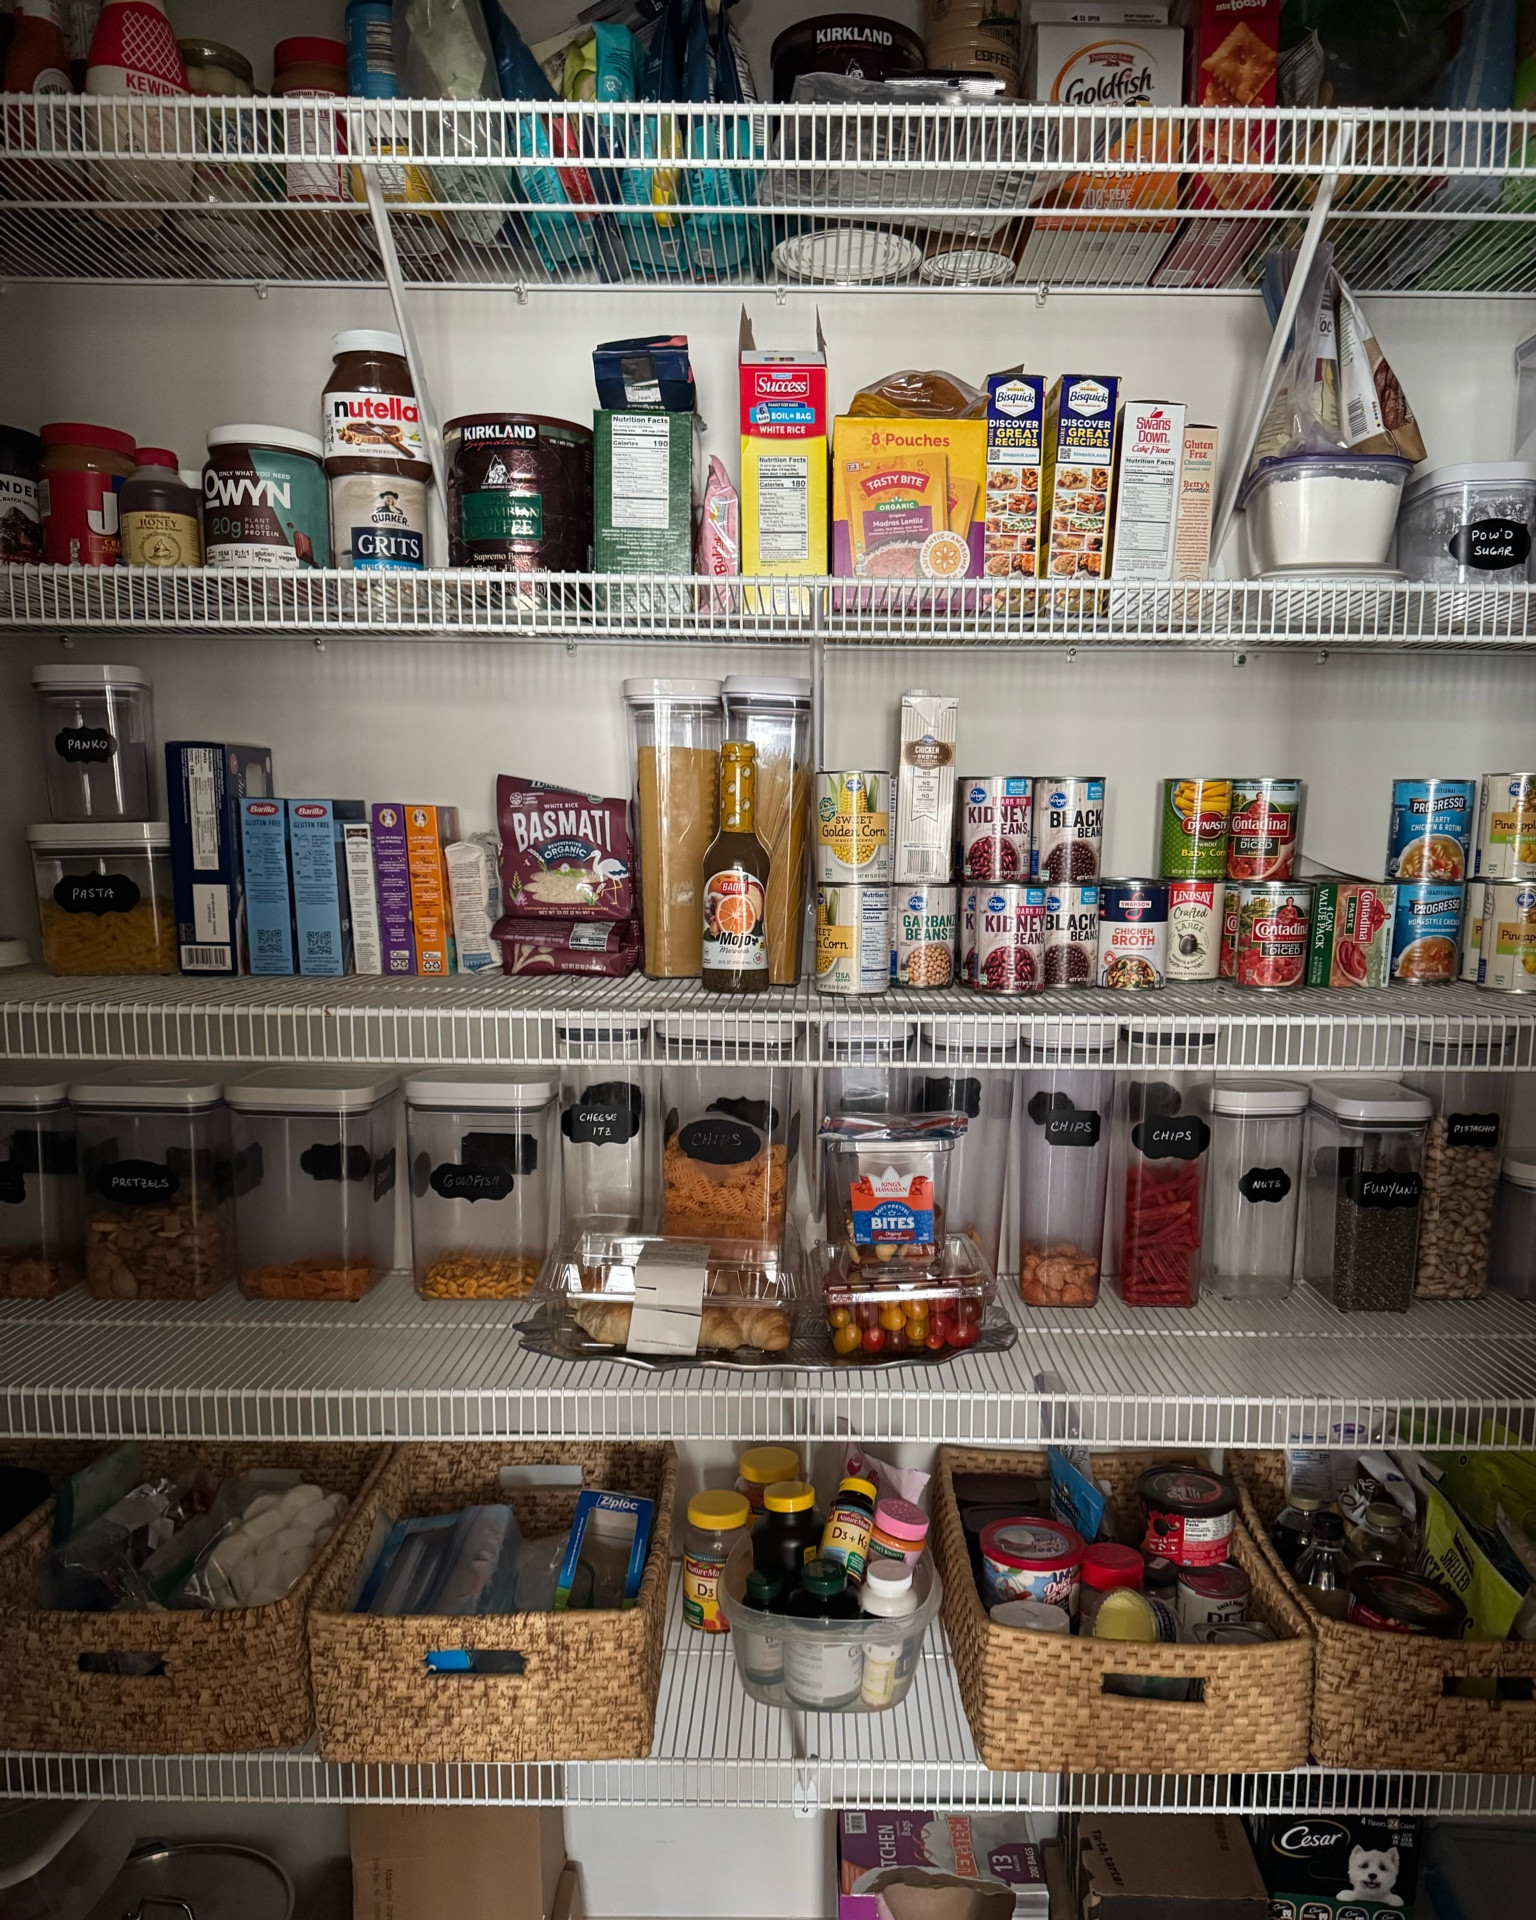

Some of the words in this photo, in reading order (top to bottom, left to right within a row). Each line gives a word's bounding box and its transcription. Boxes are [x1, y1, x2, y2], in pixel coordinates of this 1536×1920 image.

[815, 26, 894, 46] KIRKLAND
[975, 49, 1012, 66] COFFEE
[1064, 67, 1153, 104] Goldfish
[757, 378, 808, 394] Success
[997, 390, 1035, 405] Bisquick
[1069, 390, 1108, 405] Bisquick
[334, 398, 419, 424] nutella
[771, 411, 790, 421] BOIL
[795, 411, 812, 421] BAG
[612, 415, 645, 424] Nutrition
[647, 417, 669, 425] Facts
[989, 419, 1039, 429] DISCOVER
[1061, 419, 1111, 429] DISCOVER
[1136, 417, 1171, 431] Swans
[464, 425, 537, 441] KIRKLAND
[759, 425, 785, 435] WHITE
[786, 425, 806, 435] RICE
[996, 428, 1039, 439] GREAT
[1068, 428, 1111, 439] GREAT
[872, 433, 880, 446] 8
[885, 433, 951, 447] Pouches
[995, 438, 1038, 447] RECIPES
[1066, 438, 1110, 447] RECIPES
[1138, 430, 1169, 444] Down
[464, 440, 538, 452] Signature
[1132, 444, 1150, 454] Cake
[1150, 445, 1172, 455] Flour
[1184, 440, 1214, 449] Gluten
[1189, 450, 1208, 459] Free
[219, 470, 234, 478] ONLY
[272, 472, 291, 480] NEED
[204, 469, 291, 510] OWYN
[791, 480, 806, 488] 180
[866, 476, 899, 492] TASTY
[901, 474, 923, 488] BITE
[1184, 480, 1210, 490] Betty's
[879, 502, 915, 511] ORGANIC
[139, 519, 178, 529] HONEY
[371, 514, 409, 526] QUAKER
[873, 519, 900, 528] Madras
[901, 518, 923, 527] Lentils
[212, 517, 241, 538] 20g
[244, 523, 270, 531] BASED
[469, 520, 534, 537] COFFEE
[244, 530, 280, 538] PROTEIN
[1471, 528, 1514, 542] POW'D
[358, 534, 420, 559] GRITS
[921, 534, 945, 571] AUTHENTIC
[949, 534, 970, 571] AWESOME
[1472, 545, 1514, 558] SUGAR
[254, 550, 275, 559] gluten
[258, 556, 272, 564] free
[473, 552, 506, 562] Supremo
[68, 739, 108, 751] PANKO
[915, 746, 940, 754] CHICKEN
[1015, 797, 1027, 806] RED
[1413, 796, 1465, 814] PROGRESSO
[250, 805, 277, 813] Barilla
[298, 807, 325, 815] Barilla
[968, 806, 1028, 824] KIDNEY
[1050, 809, 1103, 828] BLACK
[513, 810, 612, 853] BASMATI
[822, 825, 860, 838] Golden
[862, 825, 887, 837] Corn
[991, 823, 1028, 835] BEANS
[1187, 821, 1228, 831] DYNASTY
[1231, 818, 1288, 833] Contadina
[1438, 823, 1444, 831] &
[544, 845, 588, 860] ORGANIC
[1240, 842, 1274, 850] DICED
[1181, 849, 1207, 859] Baby
[72, 887, 115, 901] PASTA
[1173, 890, 1213, 902] LINDSAY
[1016, 907, 1032, 915] DARK
[1318, 888, 1329, 921] VALUE
[1413, 898, 1460, 915] PROGRESSO
[1173, 906, 1209, 920] Crafted
[1347, 902, 1355, 929] PASTE
[1359, 890, 1374, 941] Contadina
[985, 915, 1046, 933] KIDNEY
[1046, 913, 1097, 931] BLACK
[1324, 912, 1333, 931] CAN
[905, 928, 948, 941] BEANS
[1114, 927, 1154, 937] CHICKEN
[1175, 924, 1205, 933] LARGE
[720, 931, 752, 948] Mojo
[1013, 933, 1045, 945] BEANS
[1070, 931, 1098, 942] BEANS
[1111, 936, 1156, 947] BROTH
[1314, 922, 1324, 949] PACK
[823, 939, 849, 951] Corn
[1269, 948, 1301, 956] DICED
[835, 972, 850, 980] USA
[579, 1112, 618, 1122] CHEESE
[591, 1126, 612, 1136] ITZ
[1050, 1121, 1093, 1134] CHIPS
[691, 1132, 742, 1147] CHIPS
[1152, 1130, 1193, 1141] CHIPS
[112, 1177, 169, 1189] PRETZELS
[1252, 1179, 1282, 1190] NUTS
[875, 1186, 908, 1194] HAWAIIAN
[874, 1205, 887, 1217] SOFT
[887, 1204, 910, 1216] PRETZEL
[870, 1217, 915, 1230] BITES
[600, 1495, 641, 1512] Ziploc
[1439, 1549, 1473, 1593] SHELLED
[697, 1583, 714, 1598] D3
[901, 1819, 912, 1837] Bags
[1361, 1817, 1367, 1826] 4
[1367, 1819, 1387, 1829] Flavors
[1388, 1821, 1399, 1830] 24
[1400, 1821, 1416, 1831] Count
[1280, 1825, 1343, 1850] Cesar
[1025, 1847, 1037, 1865] BAGS
[992, 1854, 1013, 1872] 13
[1028, 1865, 1040, 1879] 200
